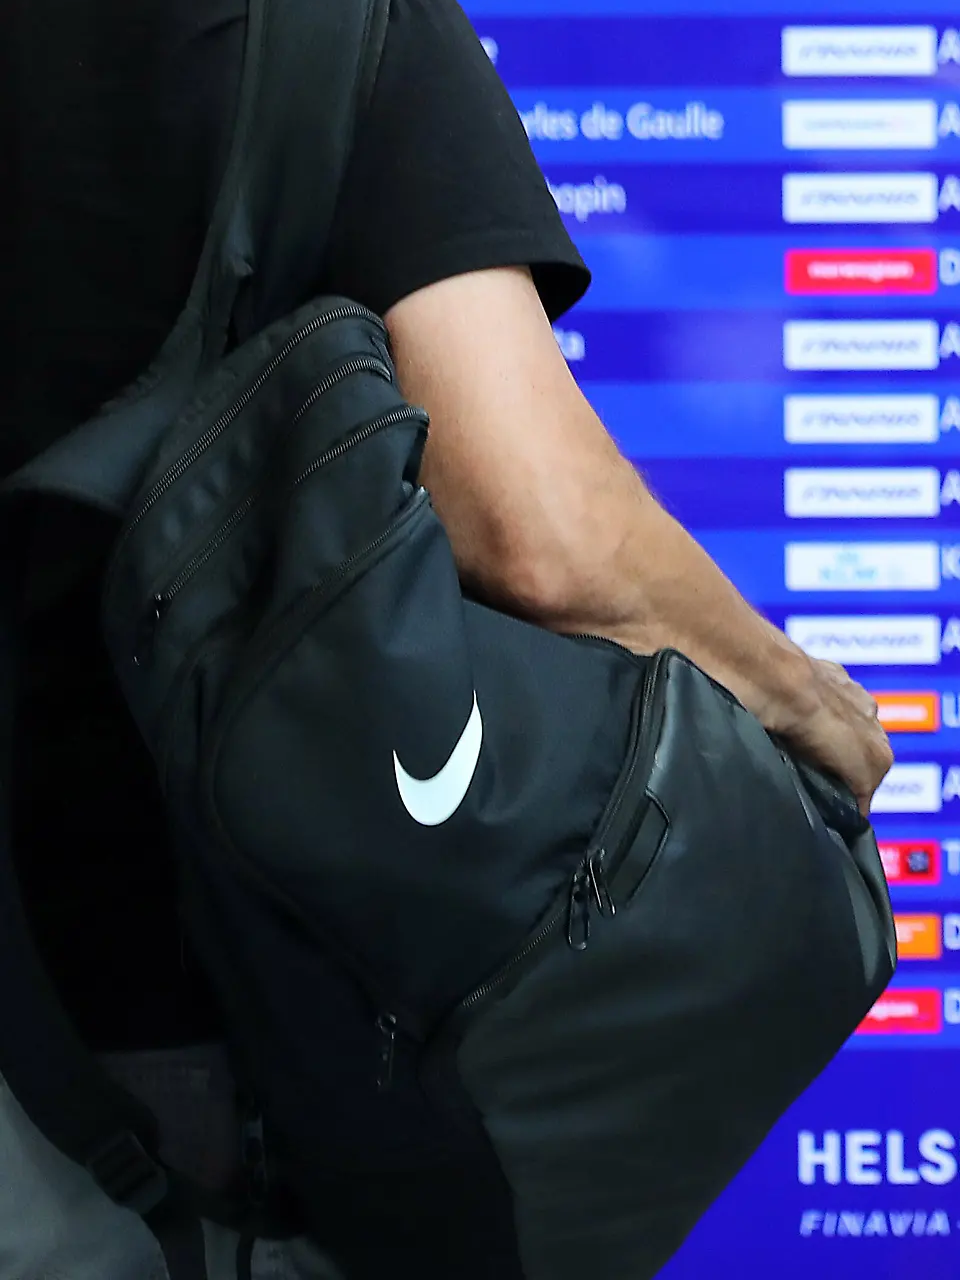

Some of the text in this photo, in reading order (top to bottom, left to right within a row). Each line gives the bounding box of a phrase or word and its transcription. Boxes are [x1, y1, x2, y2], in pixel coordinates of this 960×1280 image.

[581, 105, 623, 139] de
[627, 103, 724, 139] Gaulle
[800, 1211, 950, 1236] FINAVIA
